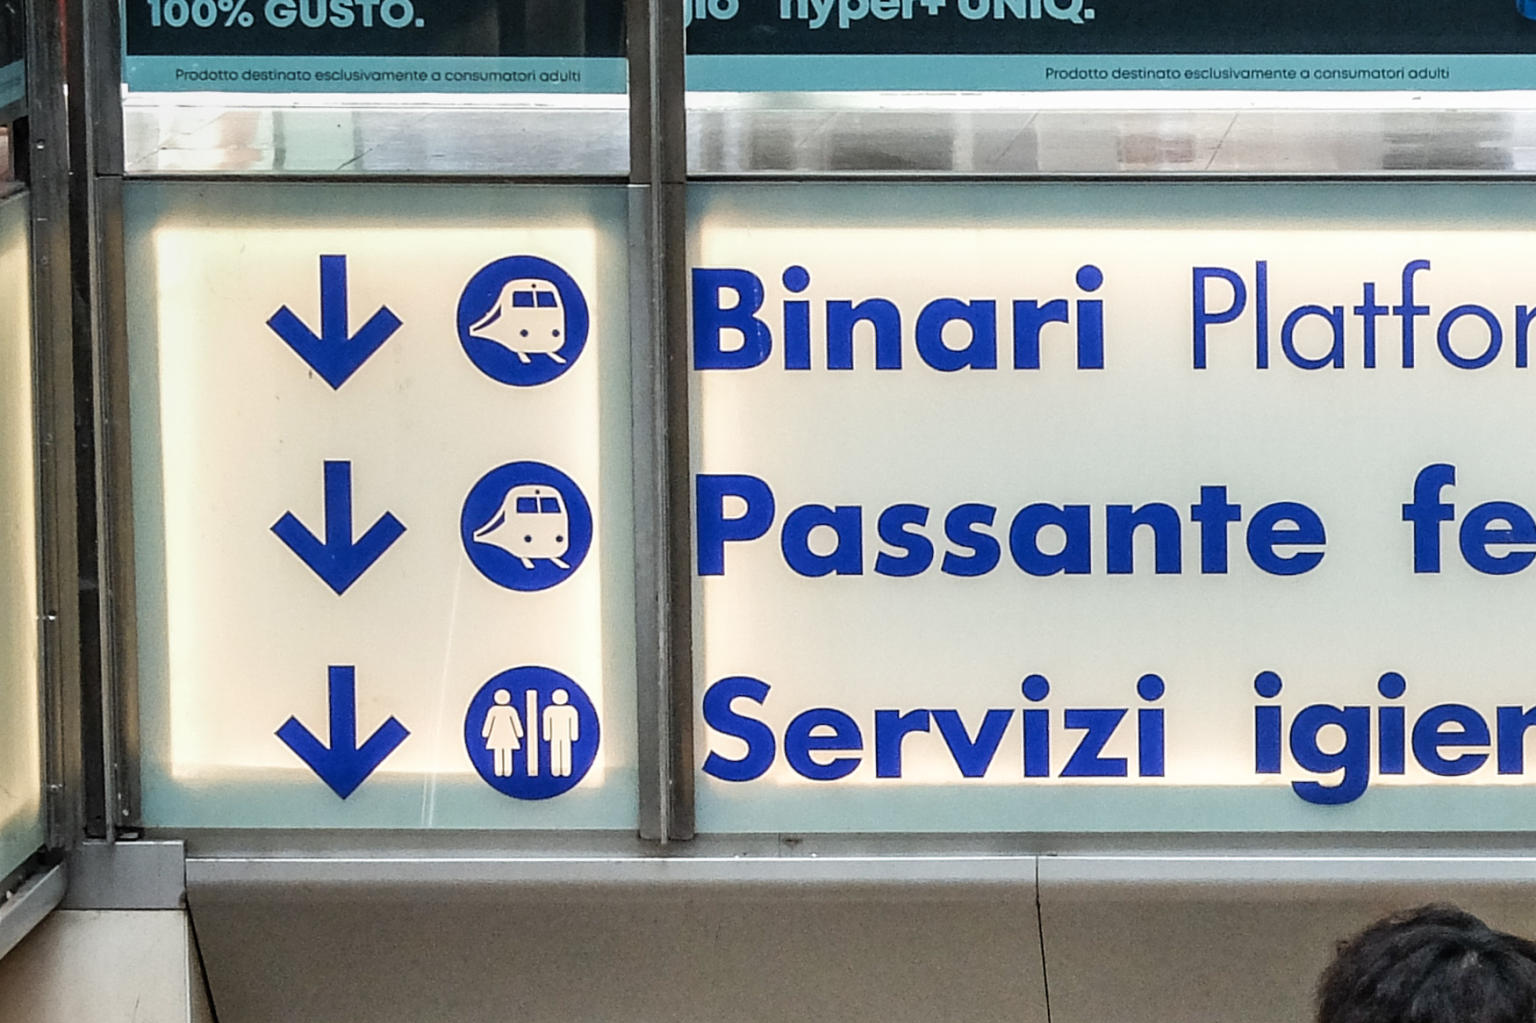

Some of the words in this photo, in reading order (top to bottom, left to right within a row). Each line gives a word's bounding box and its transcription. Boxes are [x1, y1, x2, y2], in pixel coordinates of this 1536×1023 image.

[147, 0, 254, 28] 100%
[264, 0, 425, 28] GUSTO.
[175, 68, 239, 82] Prodotto
[241, 69, 312, 83] destinato
[314, 69, 428, 83] esclusivamente
[430, 71, 442, 82] a
[444, 71, 536, 83] consumatori
[539, 69, 581, 83] adulti
[1045, 67, 1109, 80] Prodotto
[1111, 67, 1182, 80] destinato
[1183, 67, 1297, 80] esclusivamente
[1299, 69, 1311, 80] a
[1313, 67, 1405, 80] consumatori
[1407, 67, 1450, 80] adulti
[692, 265, 1104, 371] Binari
[696, 474, 1326, 577] Passante
[703, 674, 1165, 781] Servizi
